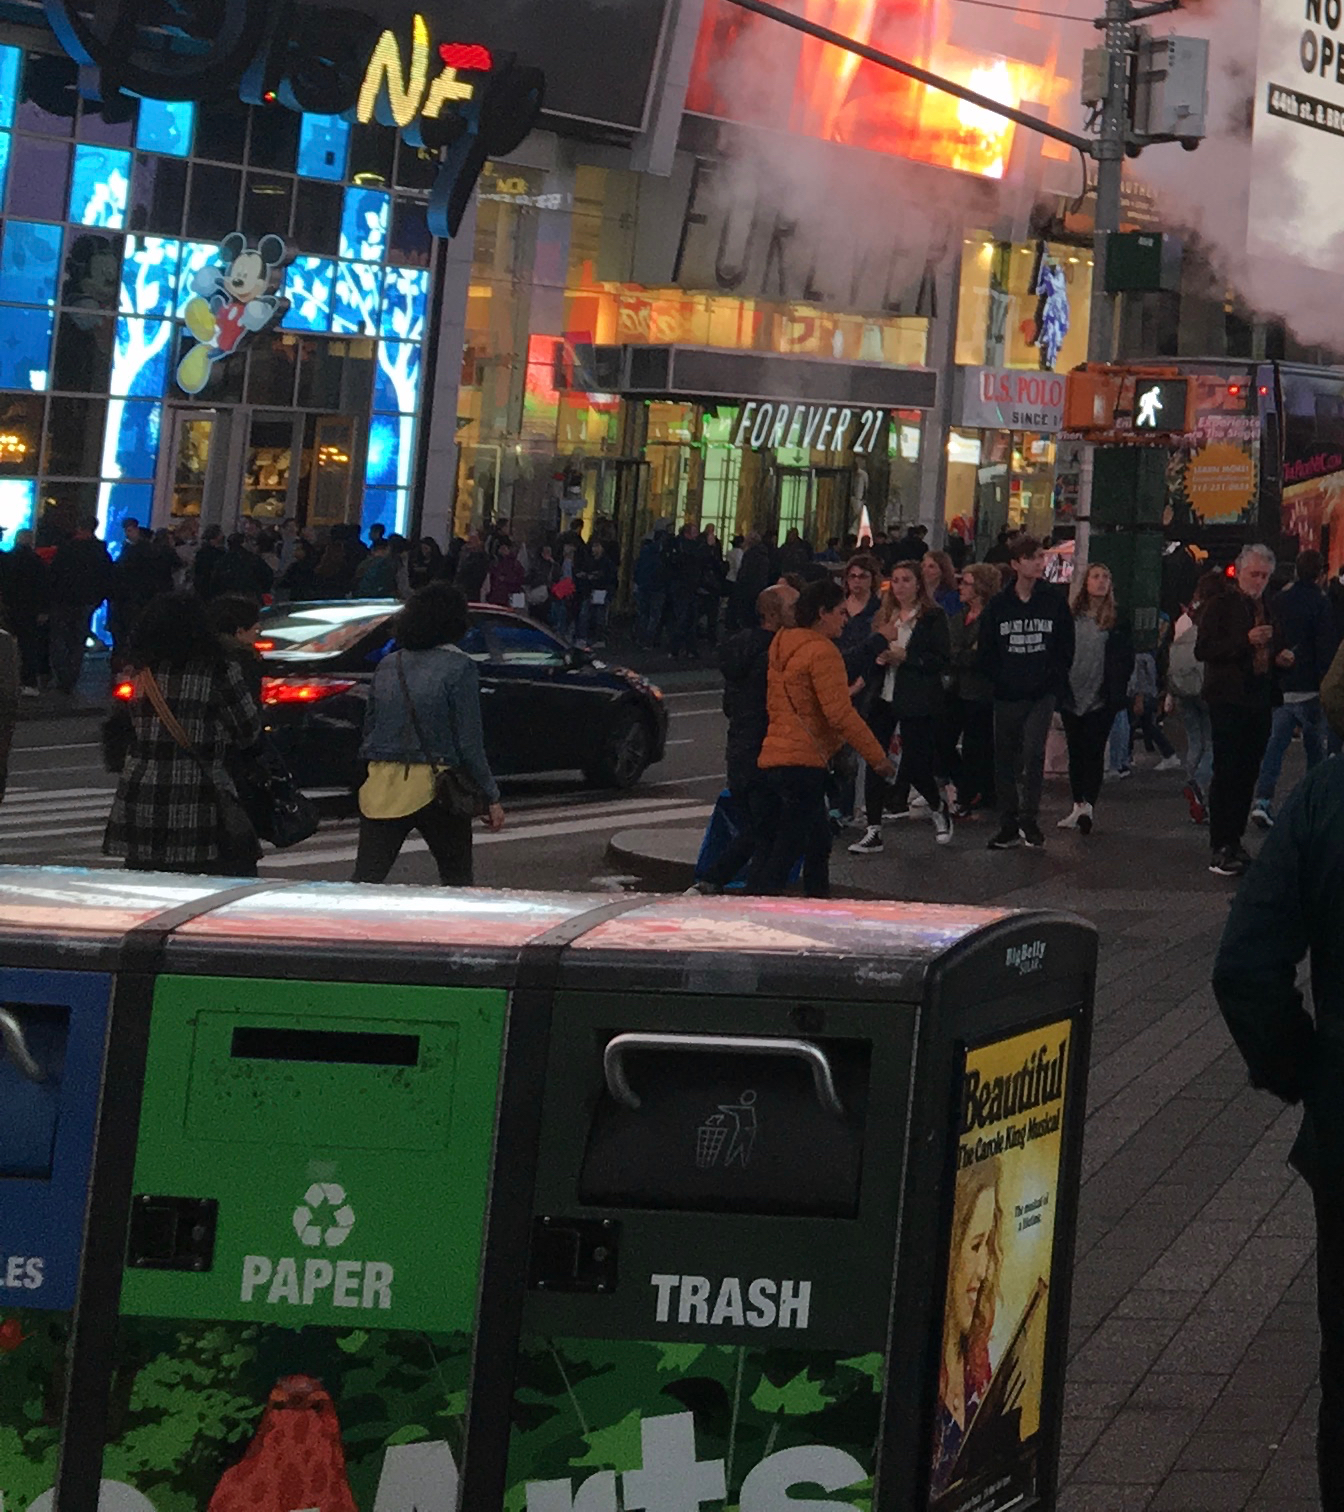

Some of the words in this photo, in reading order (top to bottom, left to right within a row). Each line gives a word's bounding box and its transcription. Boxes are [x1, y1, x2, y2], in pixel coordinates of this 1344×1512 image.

[1271, 88, 1299, 116] 44th
[981, 371, 1013, 403] U.S.
[1016, 375, 1063, 408] POLO
[735, 401, 853, 452] FOREVER
[853, 407, 884, 454] 21
[1012, 411, 1049, 426] SINCE
[962, 1039, 1067, 1135] Beautiful
[959, 1143, 976, 1170] The
[974, 1130, 1004, 1164] Carole
[1003, 1123, 1027, 1151] King
[1026, 1106, 1061, 1140] Musical
[239, 1254, 395, 1311] PAPER
[650, 1273, 813, 1330] TRASH
